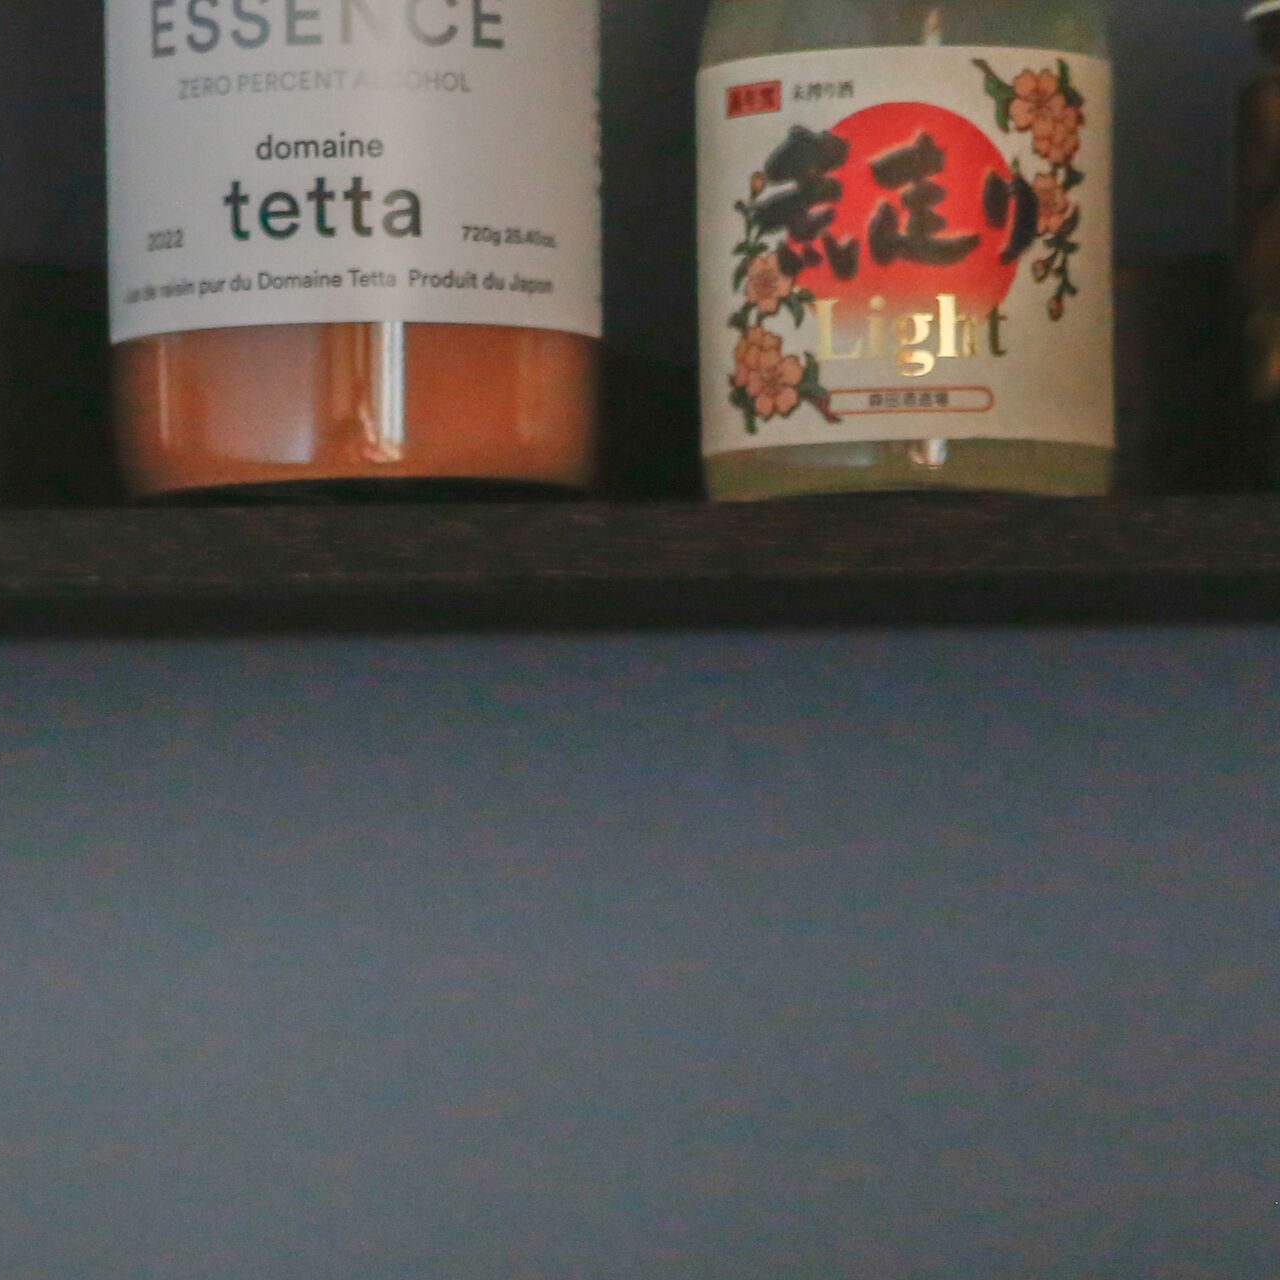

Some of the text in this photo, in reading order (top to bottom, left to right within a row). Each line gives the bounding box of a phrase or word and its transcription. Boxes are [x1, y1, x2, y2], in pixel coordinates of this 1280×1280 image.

[178, 71, 473, 100] ZERO PERCENT AOHOL
[256, 133, 384, 161] domaine
[224, 176, 422, 241] tetta
[460, 225, 502, 247] 720g
[198, 278, 227, 299] pur
[228, 271, 252, 292] du
[256, 269, 343, 291] Domaine
[347, 268, 397, 288] Tetta
[408, 268, 478, 290] Produit
[481, 271, 506, 291] du
[815, 293, 1008, 377] Light
